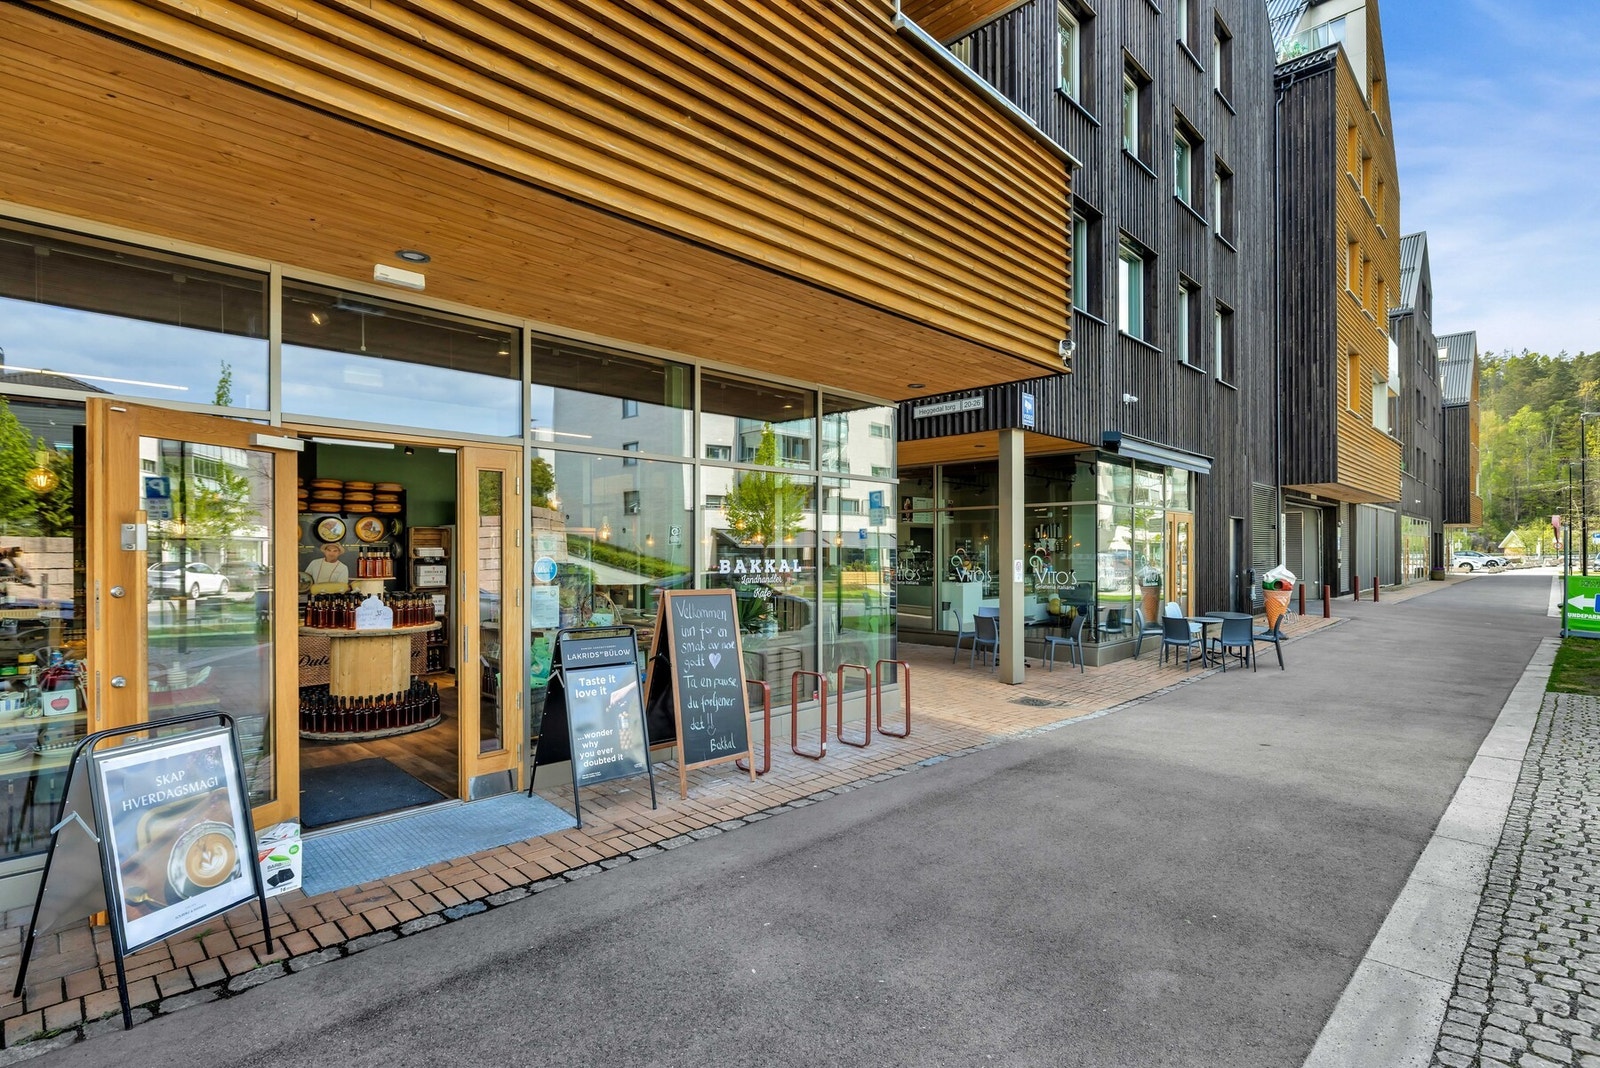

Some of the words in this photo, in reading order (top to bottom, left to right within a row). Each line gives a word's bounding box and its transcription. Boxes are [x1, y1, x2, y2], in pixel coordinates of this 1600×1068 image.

[918, 406, 944, 416] Heggedal
[945, 404, 956, 412] torg
[964, 400, 981, 408] 20-26
[719, 559, 802, 574] BAKKAL
[897, 568, 921, 581] ITO'S
[753, 587, 773, 600] Kafe
[676, 600, 727, 621] Velkommen
[682, 626, 696, 638] inn
[700, 622, 715, 640] for
[718, 628, 728, 638] en
[681, 640, 706, 654] smak
[708, 641, 720, 650] av
[722, 640, 736, 650] noe
[567, 652, 600, 660] LAKRIDS
[604, 649, 630, 657] BÜLOW
[684, 654, 706, 673] godt
[579, 677, 606, 686] Taste
[608, 674, 616, 683] it
[683, 675, 698, 689] Ta
[700, 677, 712, 688] en
[576, 689, 596, 698] love
[600, 686, 607, 695] it
[687, 696, 699, 709] du
[690, 718, 705, 731] det
[582, 741, 598, 749] why
[580, 751, 594, 760] you
[584, 754, 616, 768] doubted
[155, 770, 185, 787] SKAP
[122, 777, 219, 811] HVERDAGSMAGI
